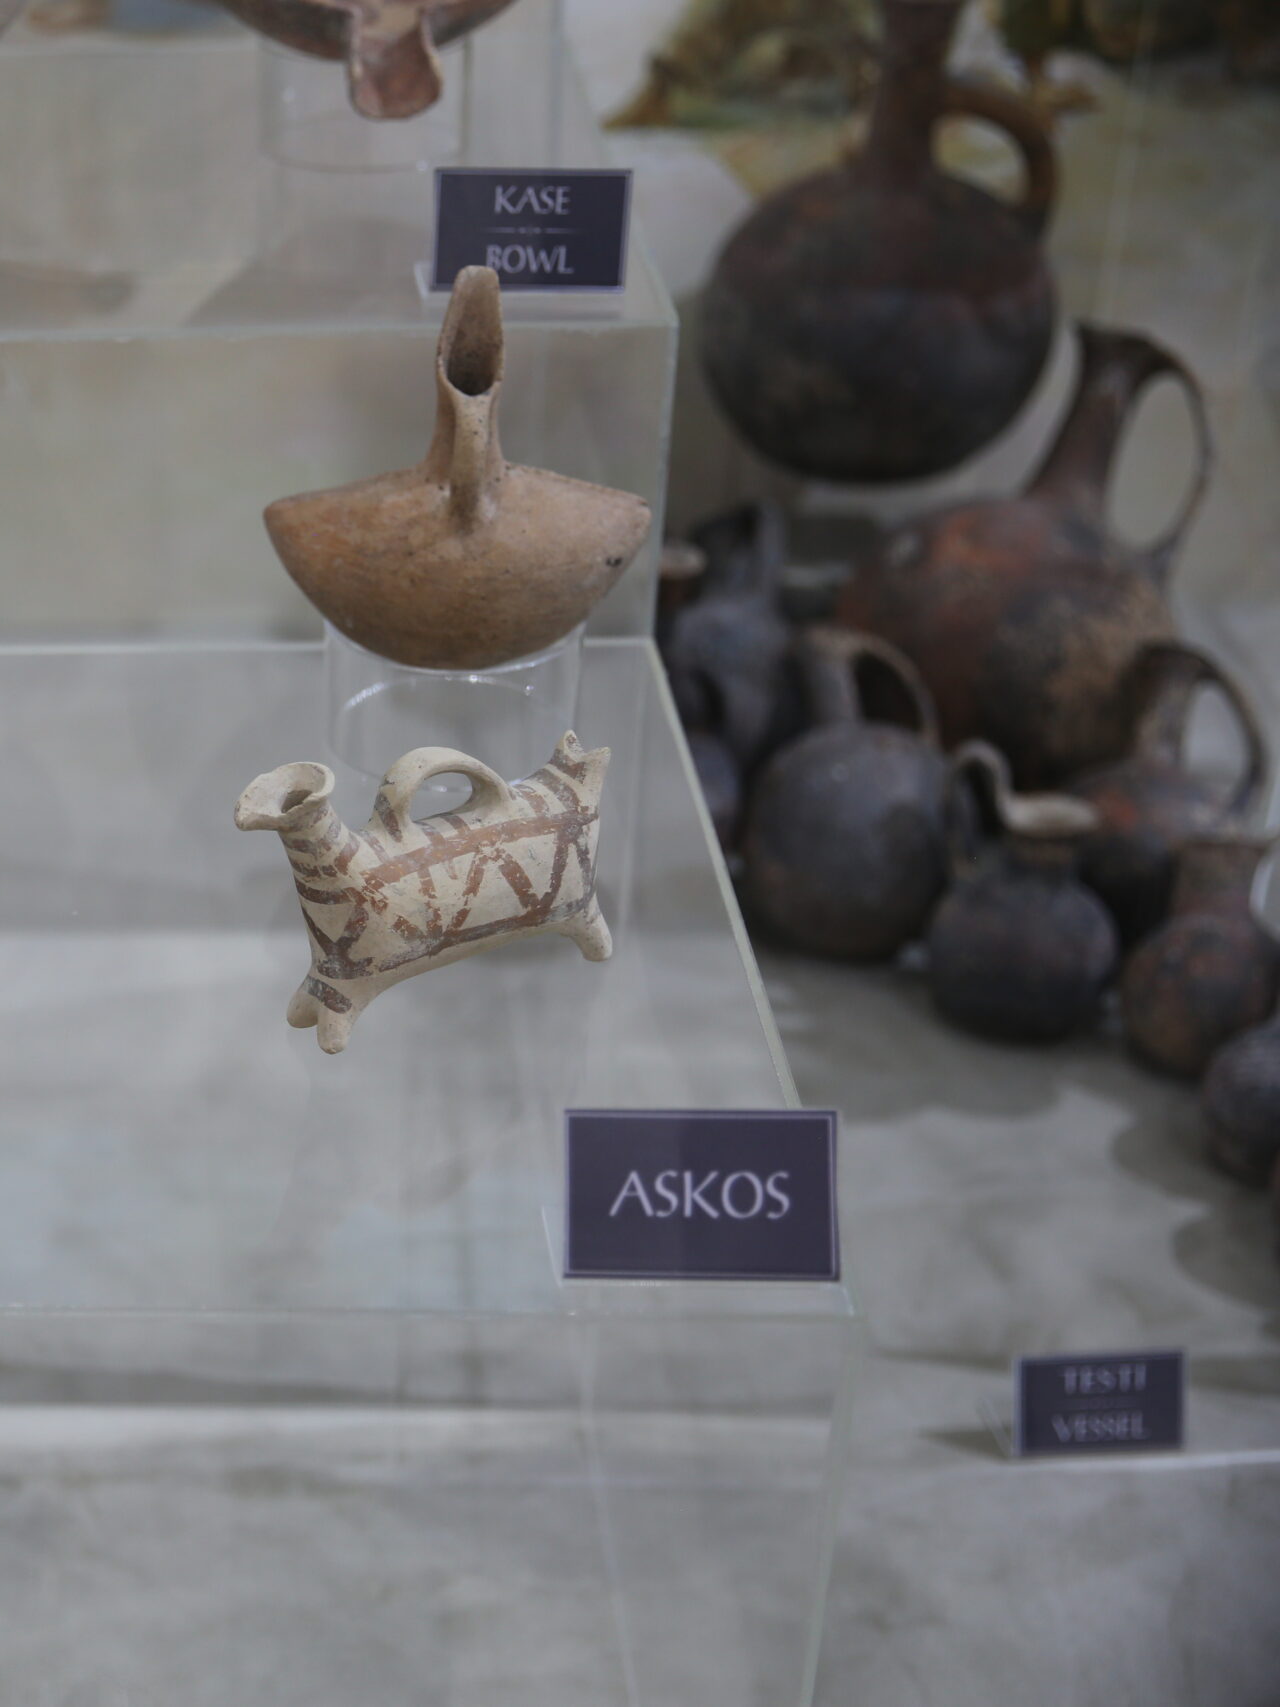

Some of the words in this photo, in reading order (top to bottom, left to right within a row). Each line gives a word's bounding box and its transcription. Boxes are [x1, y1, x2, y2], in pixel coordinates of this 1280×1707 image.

[494, 185, 571, 215] KASE
[486, 244, 575, 275] BOWL
[609, 1170, 791, 1220] ASKOS
